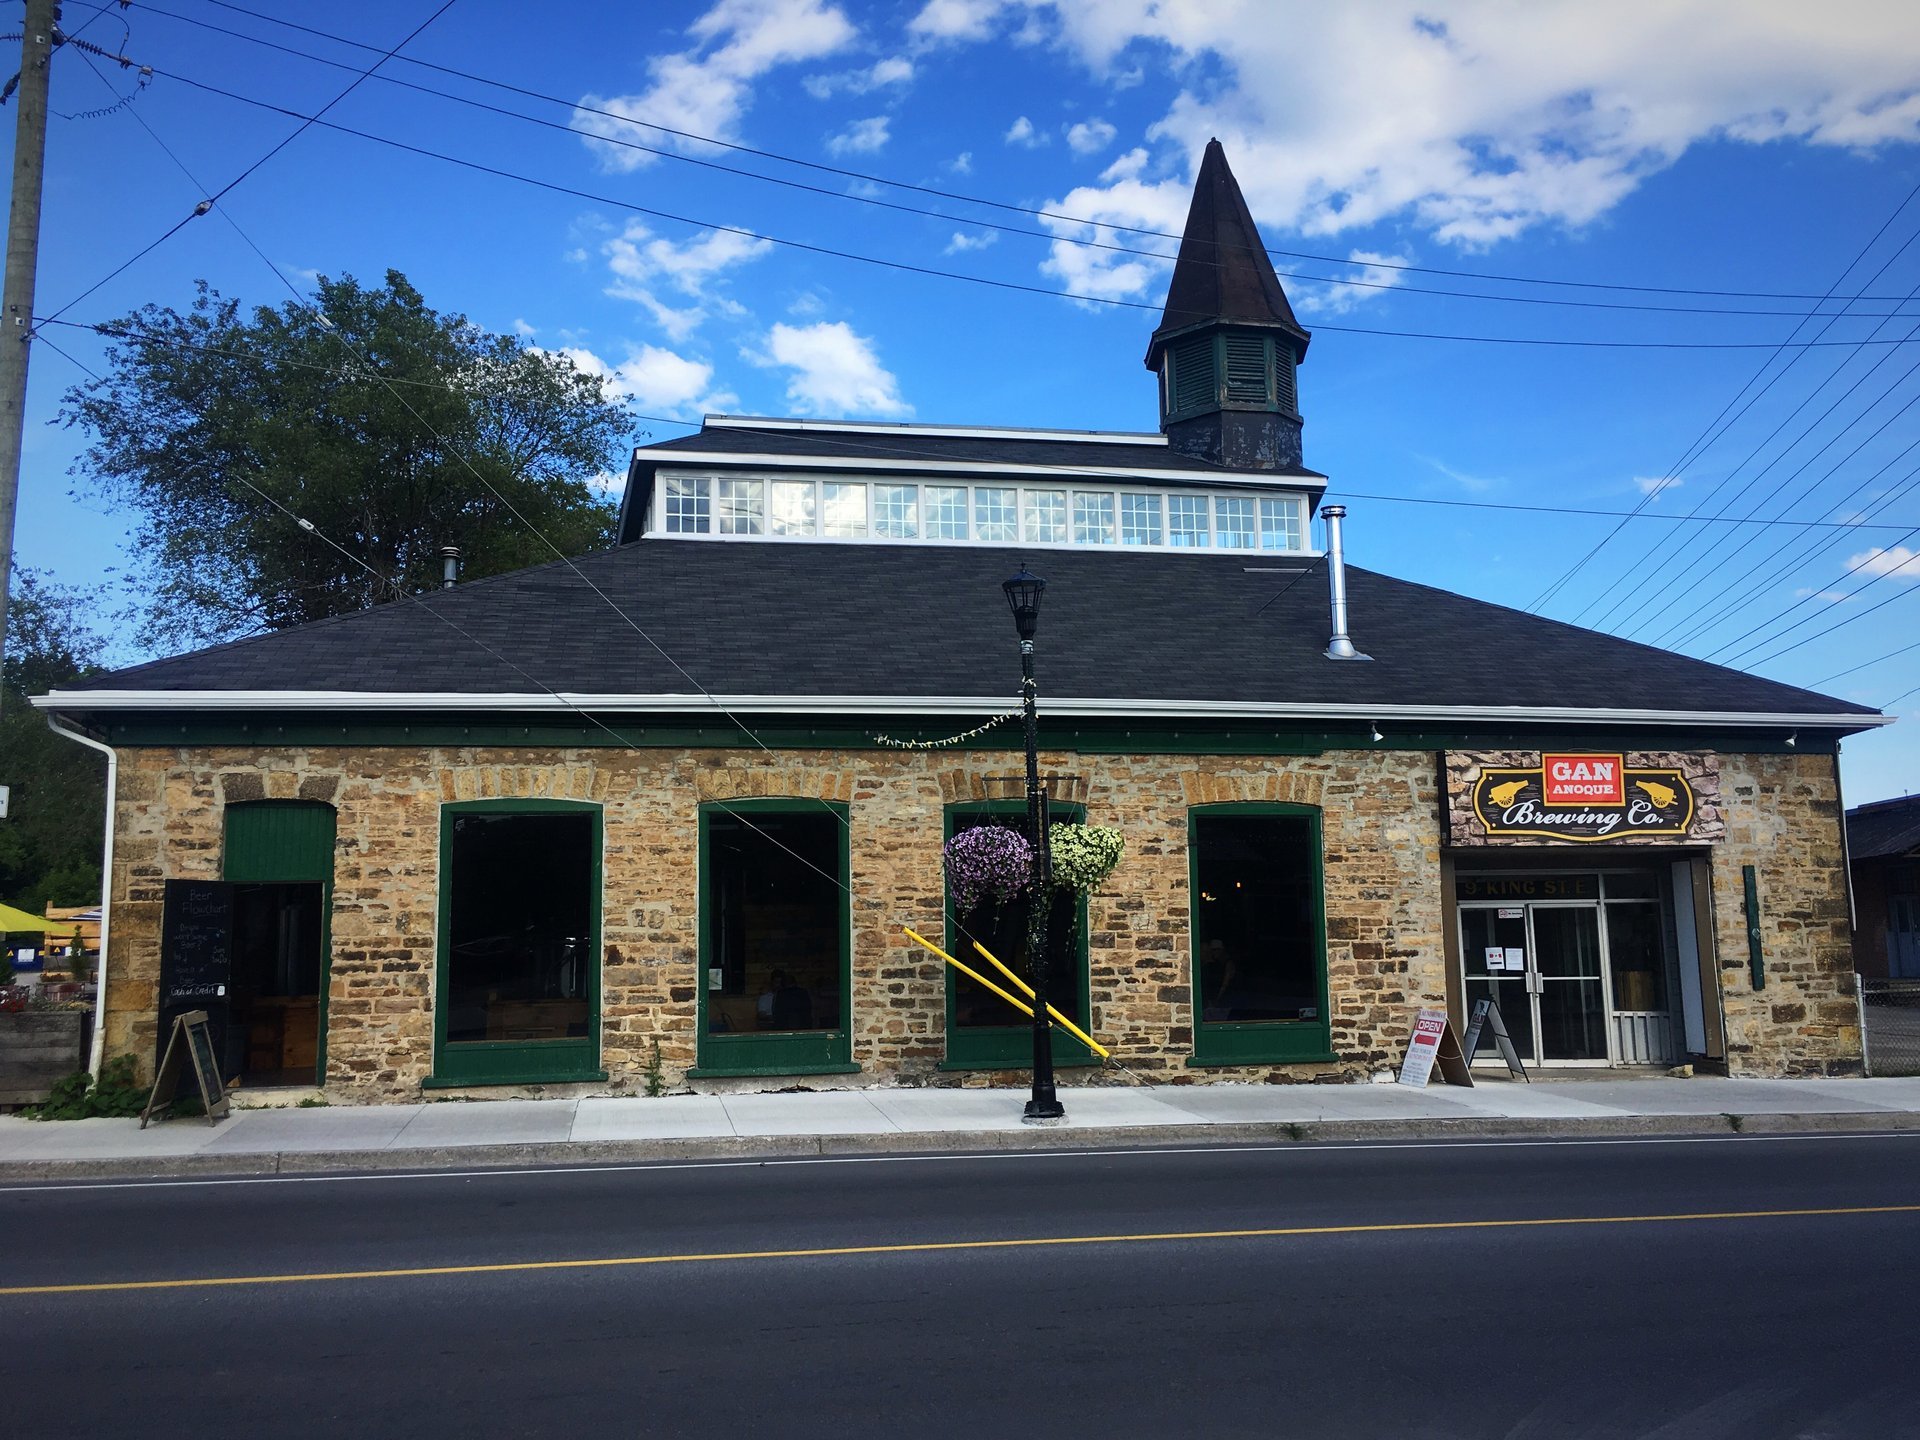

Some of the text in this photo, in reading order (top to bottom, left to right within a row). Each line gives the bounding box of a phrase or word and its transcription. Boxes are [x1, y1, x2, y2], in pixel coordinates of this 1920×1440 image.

[1552, 762, 1614, 781] GAN
[1553, 784, 1615, 795] ANOQUE
[1502, 799, 1664, 835] Brewing Co.
[1487, 880, 1536, 895] KING
[190, 889, 213, 901] Beer
[182, 902, 229, 914] Flowchart
[195, 985, 214, 996] Credit
[1418, 1021, 1441, 1032] OPEN
